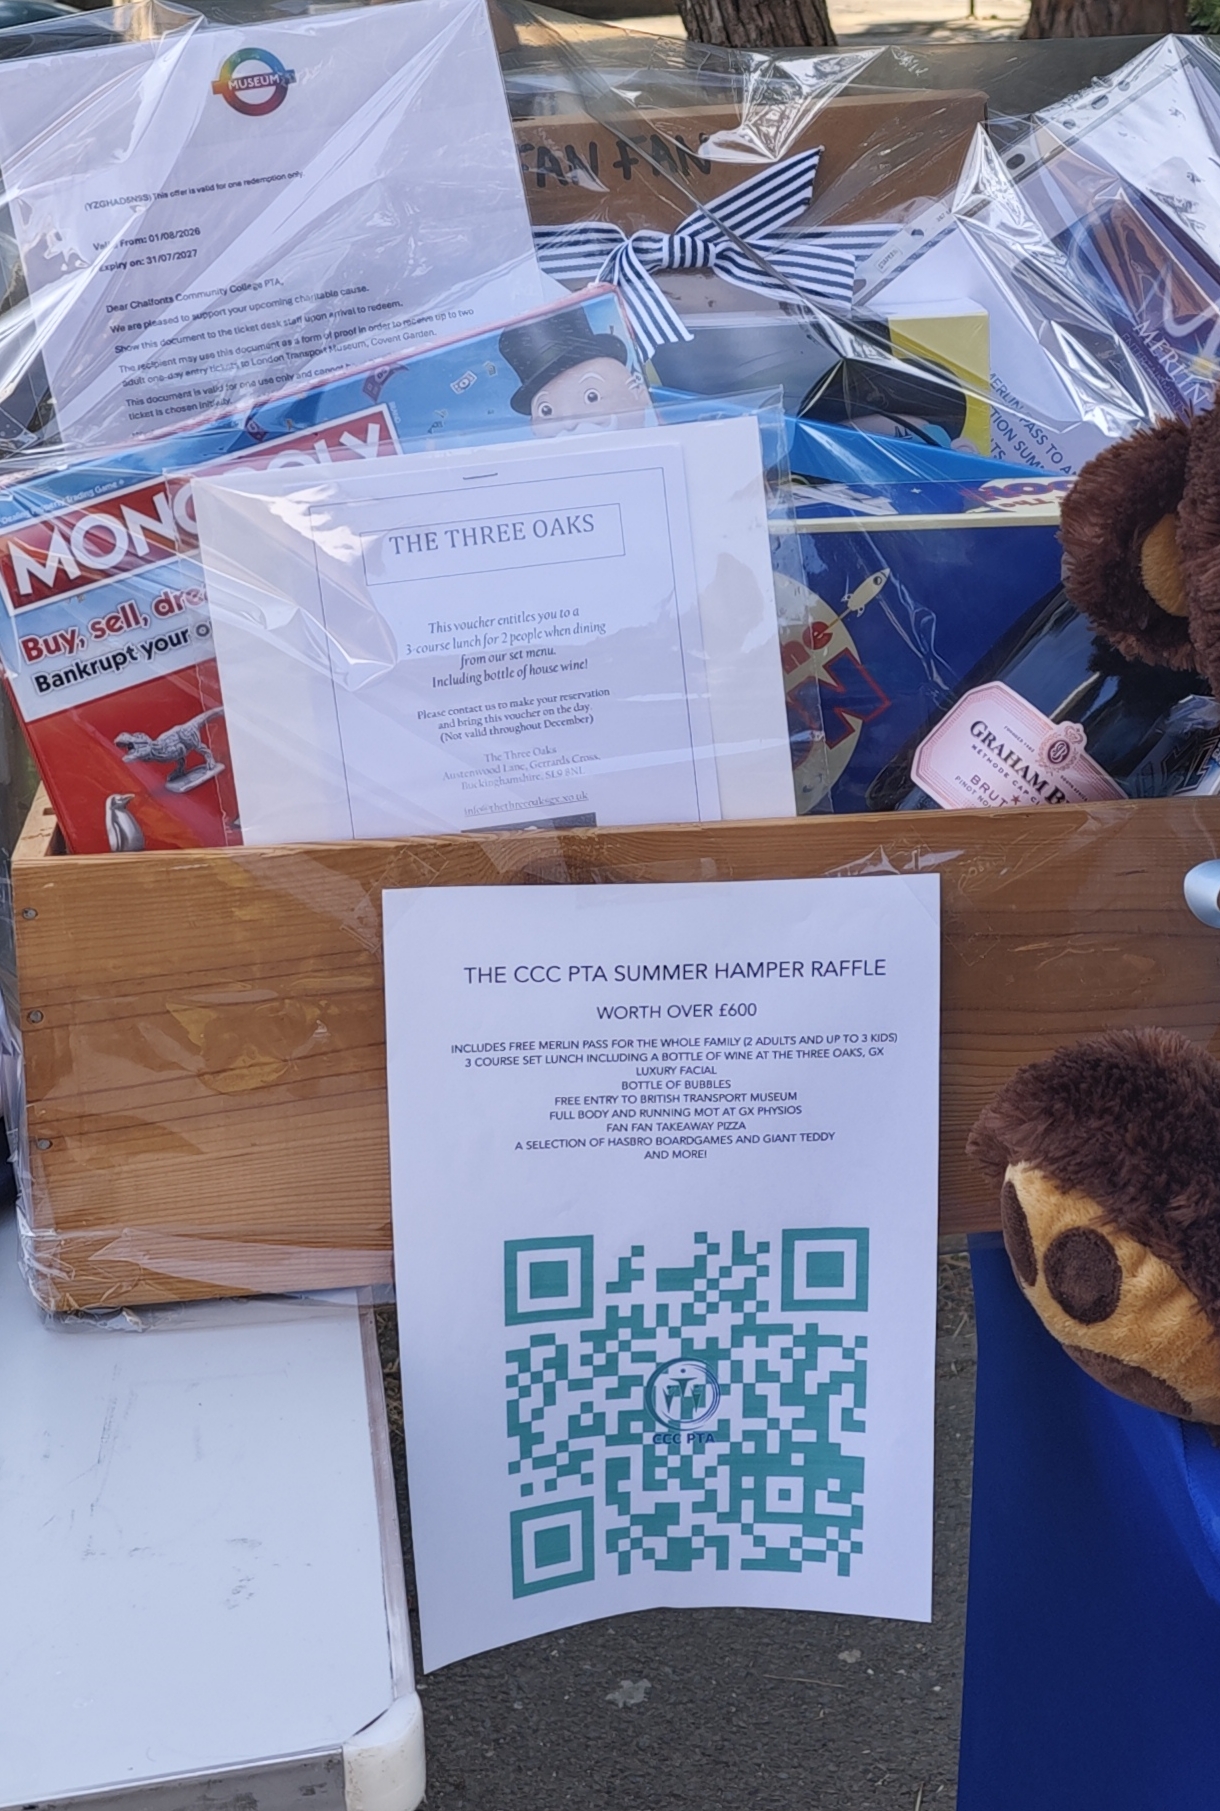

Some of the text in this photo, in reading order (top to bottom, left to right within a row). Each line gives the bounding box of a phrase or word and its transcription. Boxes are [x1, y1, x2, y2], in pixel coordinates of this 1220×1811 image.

[227, 74, 280, 90] MUSEUM
[612, 131, 712, 181] FAN
[119, 236, 148, 248] From:
[148, 227, 201, 243] 01/08/2026
[129, 258, 145, 268] on:
[146, 249, 199, 265] 31/07/2027
[106, 303, 129, 314] Dear
[130, 297, 175, 311] Chalfonts
[175, 287, 228, 302] Community
[229, 282, 263, 294] College
[1132, 320, 1212, 405] MERLIN
[990, 410, 1017, 442] TION
[1013, 440, 1045, 470] SUM
[1044, 443, 1064, 465] TO
[95, 481, 119, 496] Game
[389, 513, 596, 555] THE THREE OAKS
[19, 586, 210, 662] Buy, sell, dre
[428, 608, 580, 634] This voucher entitles you to a
[405, 621, 607, 656] 3-course lunch for 2 people when dining
[34, 628, 191, 694] Bankrupt your
[459, 648, 557, 670] from our set menu.
[432, 658, 588, 688] Including bottle of house wine!
[970, 720, 1050, 796] GRAHAM
[954, 775, 977, 796] PINOT
[969, 774, 1009, 807] BRUT
[1012, 780, 1030, 796] CAP
[464, 959, 887, 985] THE CCC PTA SUMMER HAMPER RAFFLE
[596, 1002, 758, 1021] WORTH OVER £600
[451, 1033, 898, 1054] INCLUDES FREE MERLIN PASS FOR THE WHOLE FAMILY (2 ADULTS AND UP TO 3 KIDS)
[465, 1047, 884, 1067] 3 COURSE SET LUNCH INCLUDING A BOTTLE OF WINE AT THE THREE OAKS, GX
[636, 1066, 717, 1076] LUXURY FACIAL
[621, 1079, 731, 1090] BOTTLE OF BUBBLES
[554, 1092, 798, 1106] FREE ENTRY TO BRITISH TRANSPORT MUSEUM
[549, 1105, 802, 1120] FULL BODY AND RUNNING MOT AT GX PHYSIOS
[606, 1121, 746, 1132] FAN FAN TAKEAWAY PIZZA
[514, 1132, 836, 1150] A SELECTION OF HASBRO BOARDGAMES AND GIANT TEDDY
[644, 1149, 708, 1160] AND MORE!
[652, 1433, 715, 1444] CCC PTA
